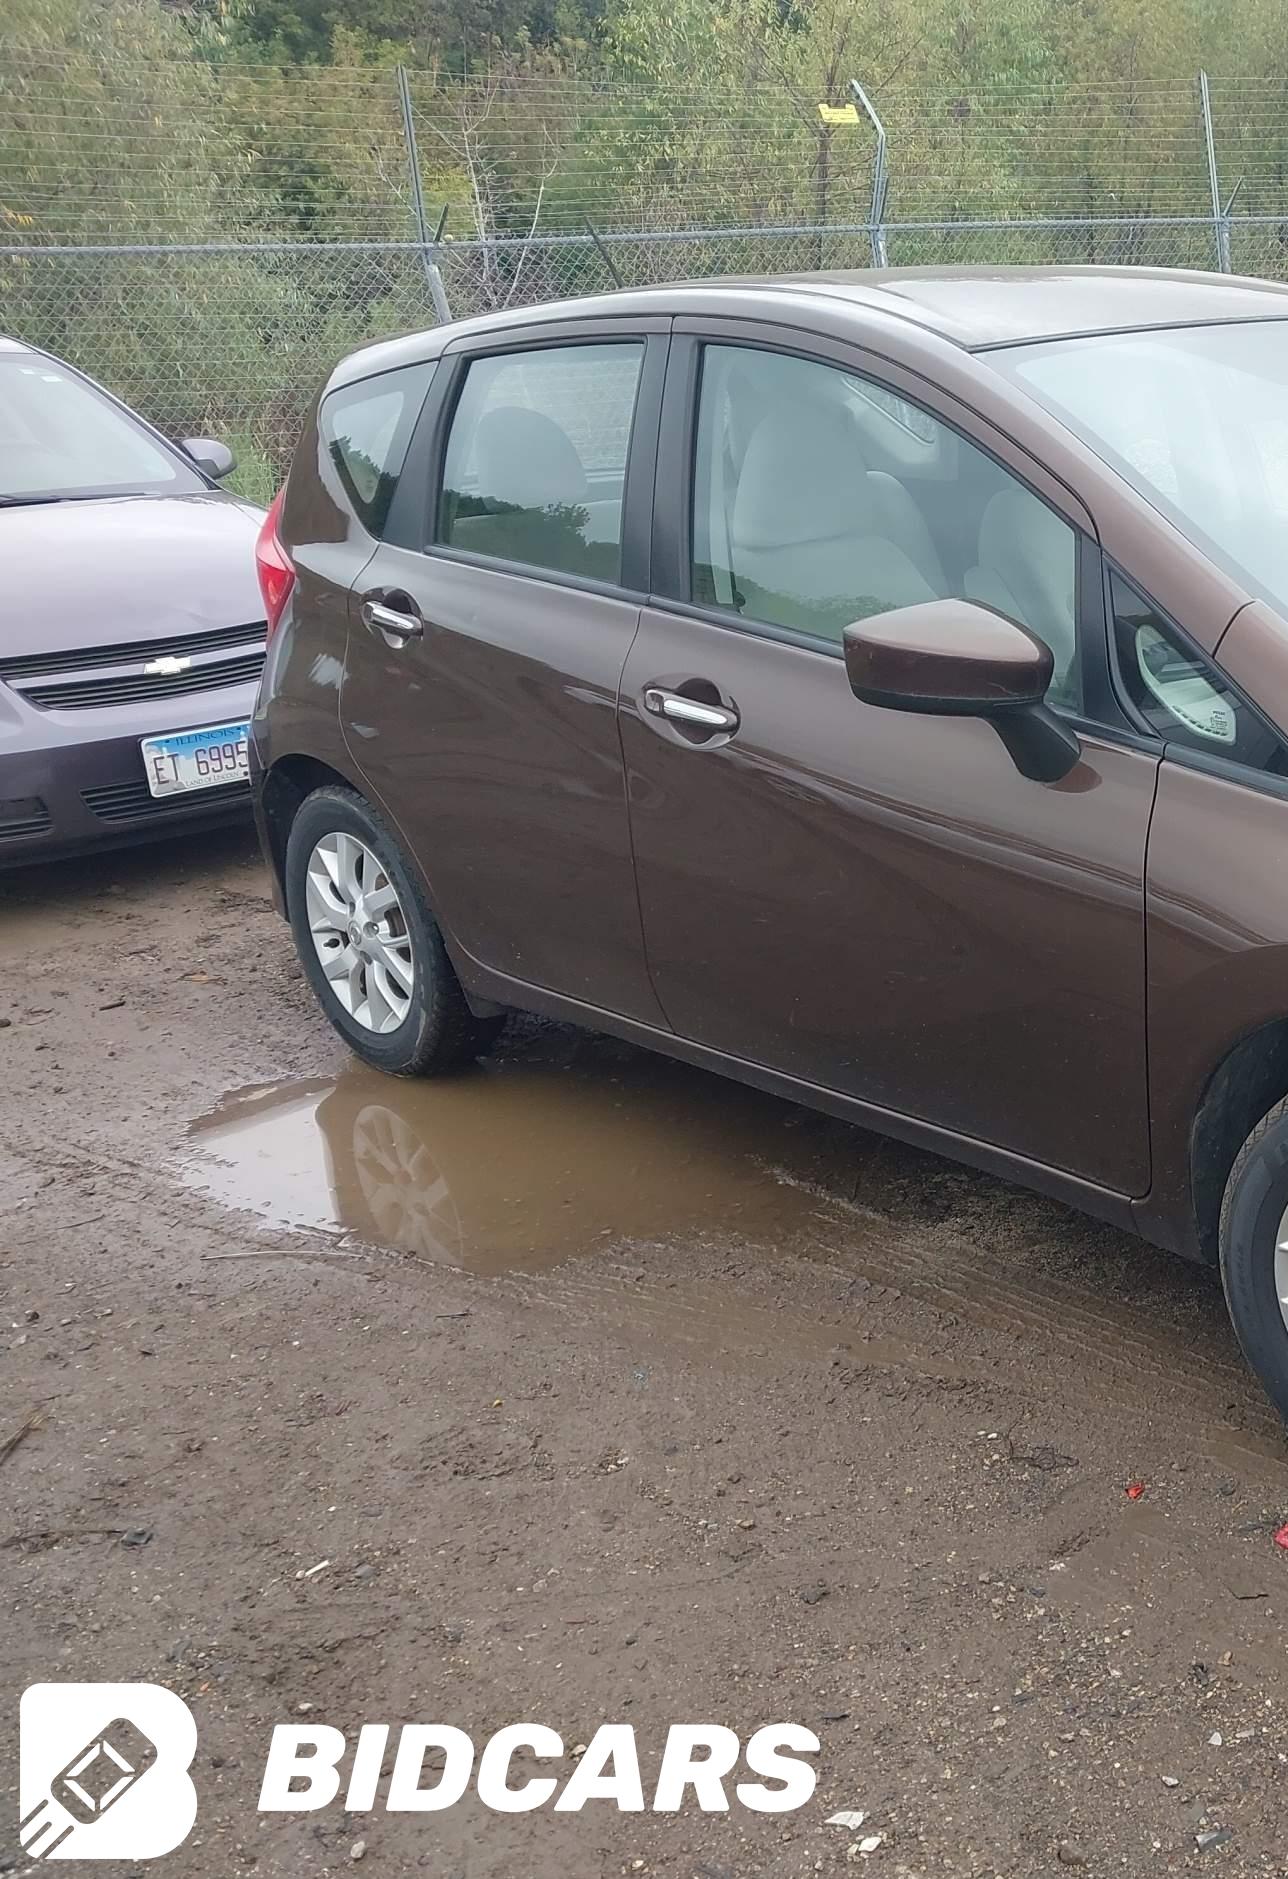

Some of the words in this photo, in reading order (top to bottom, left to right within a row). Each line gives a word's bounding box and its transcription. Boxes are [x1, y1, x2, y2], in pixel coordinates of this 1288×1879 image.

[176, 729, 235, 746] ILLINOIS
[153, 753, 179, 785] ET
[195, 740, 248, 776] 6995
